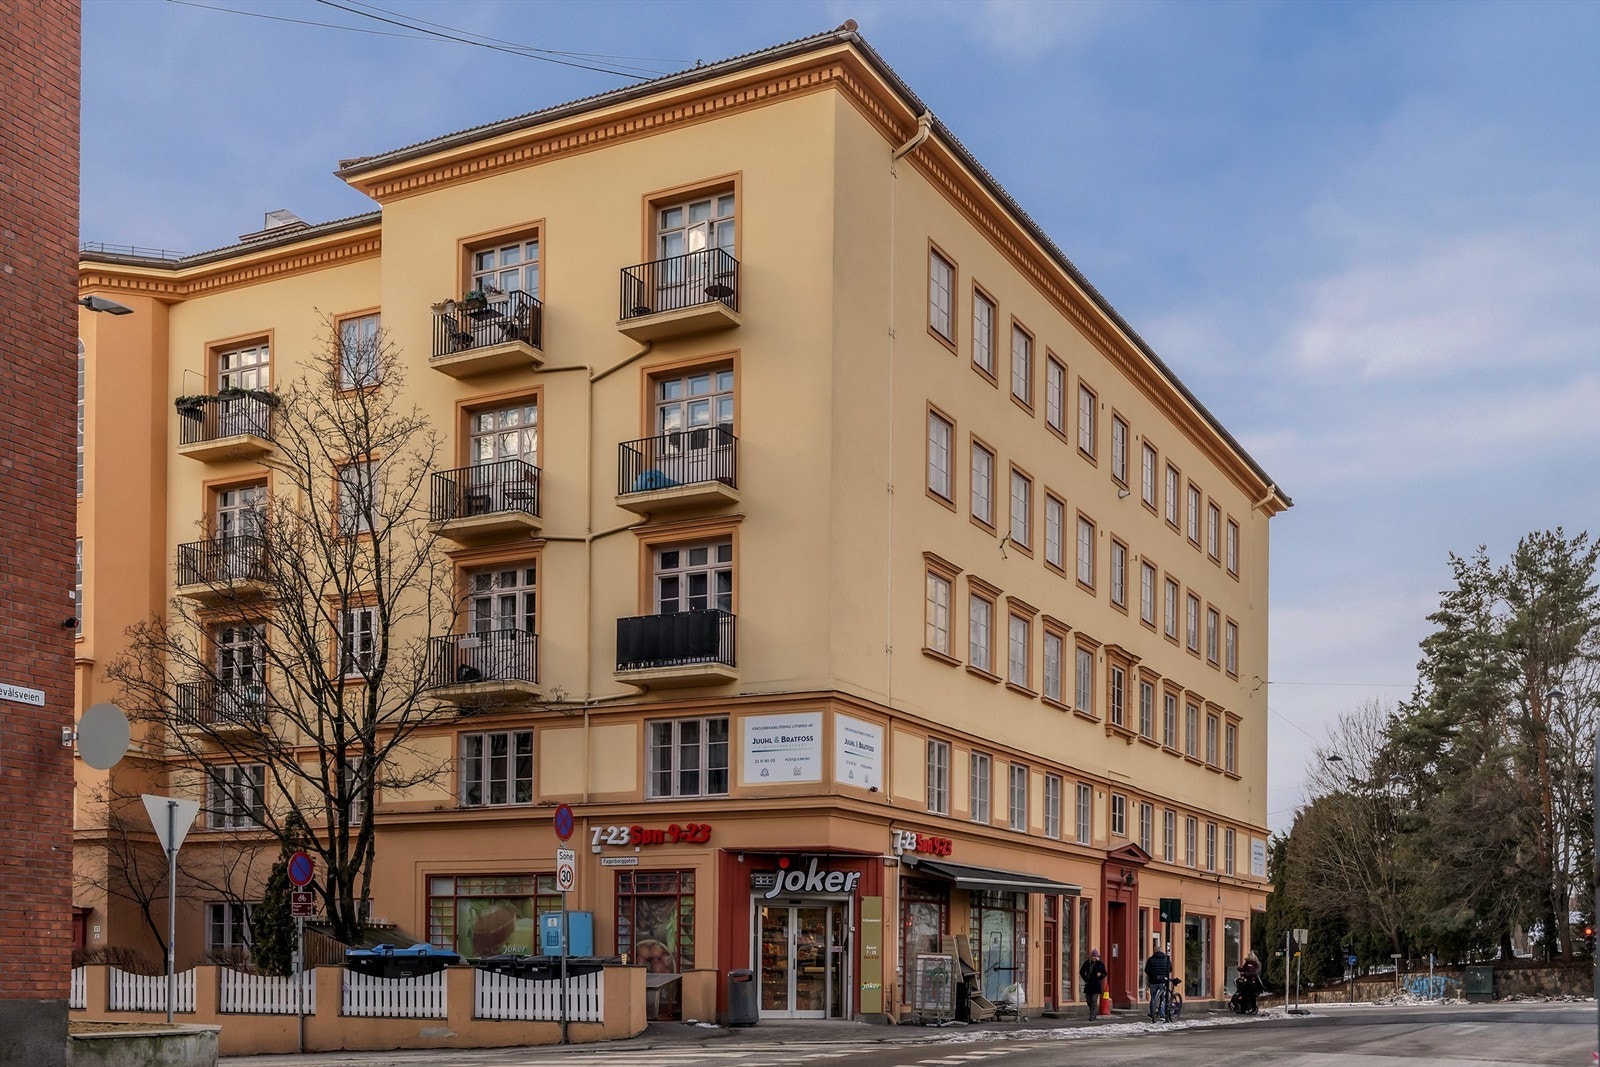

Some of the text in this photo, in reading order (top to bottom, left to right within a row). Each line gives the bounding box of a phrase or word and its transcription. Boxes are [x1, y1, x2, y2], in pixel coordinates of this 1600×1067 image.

[781, 735, 814, 743] BRATFOSS
[590, 823, 712, 845] 7-23 Søn 9-23
[561, 870, 572, 882] 30
[765, 857, 861, 899] joker
[503, 943, 527, 955] joker
